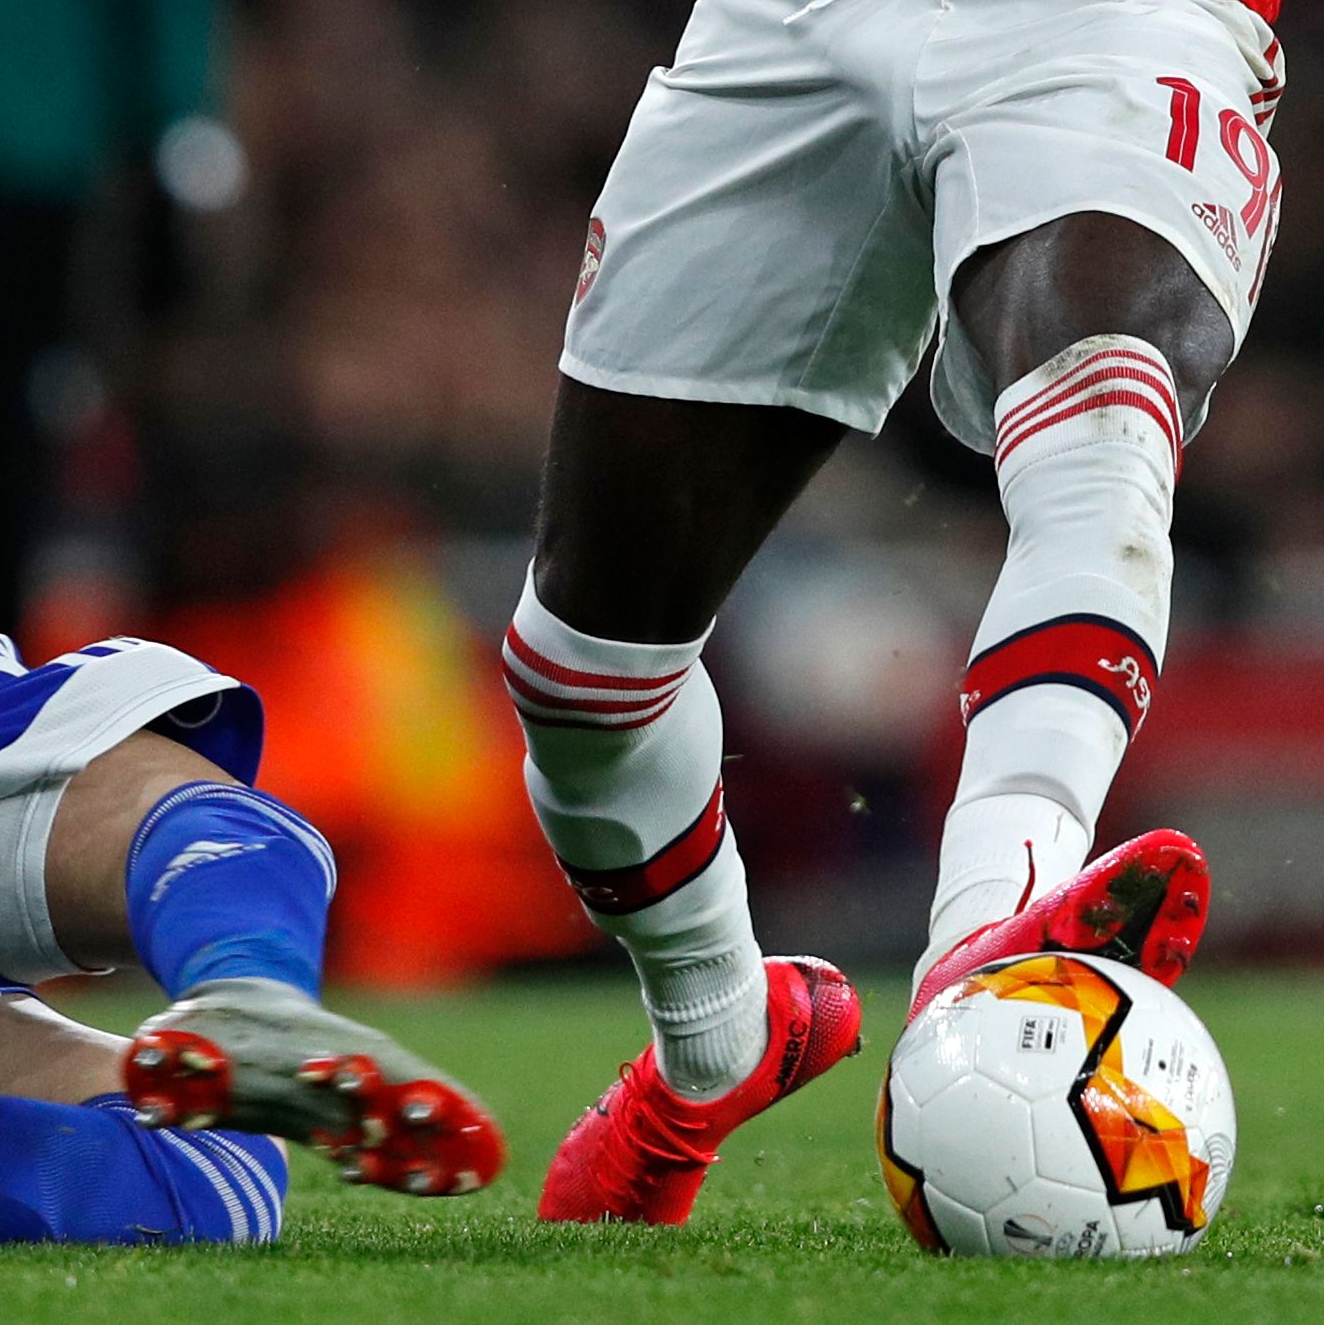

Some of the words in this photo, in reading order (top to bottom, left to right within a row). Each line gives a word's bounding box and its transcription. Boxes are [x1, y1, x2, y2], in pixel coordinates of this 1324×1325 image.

[1155, 76, 1271, 240] 19
[1191, 202, 1242, 272] adidas
[1021, 1019, 1036, 1049] FIFA
